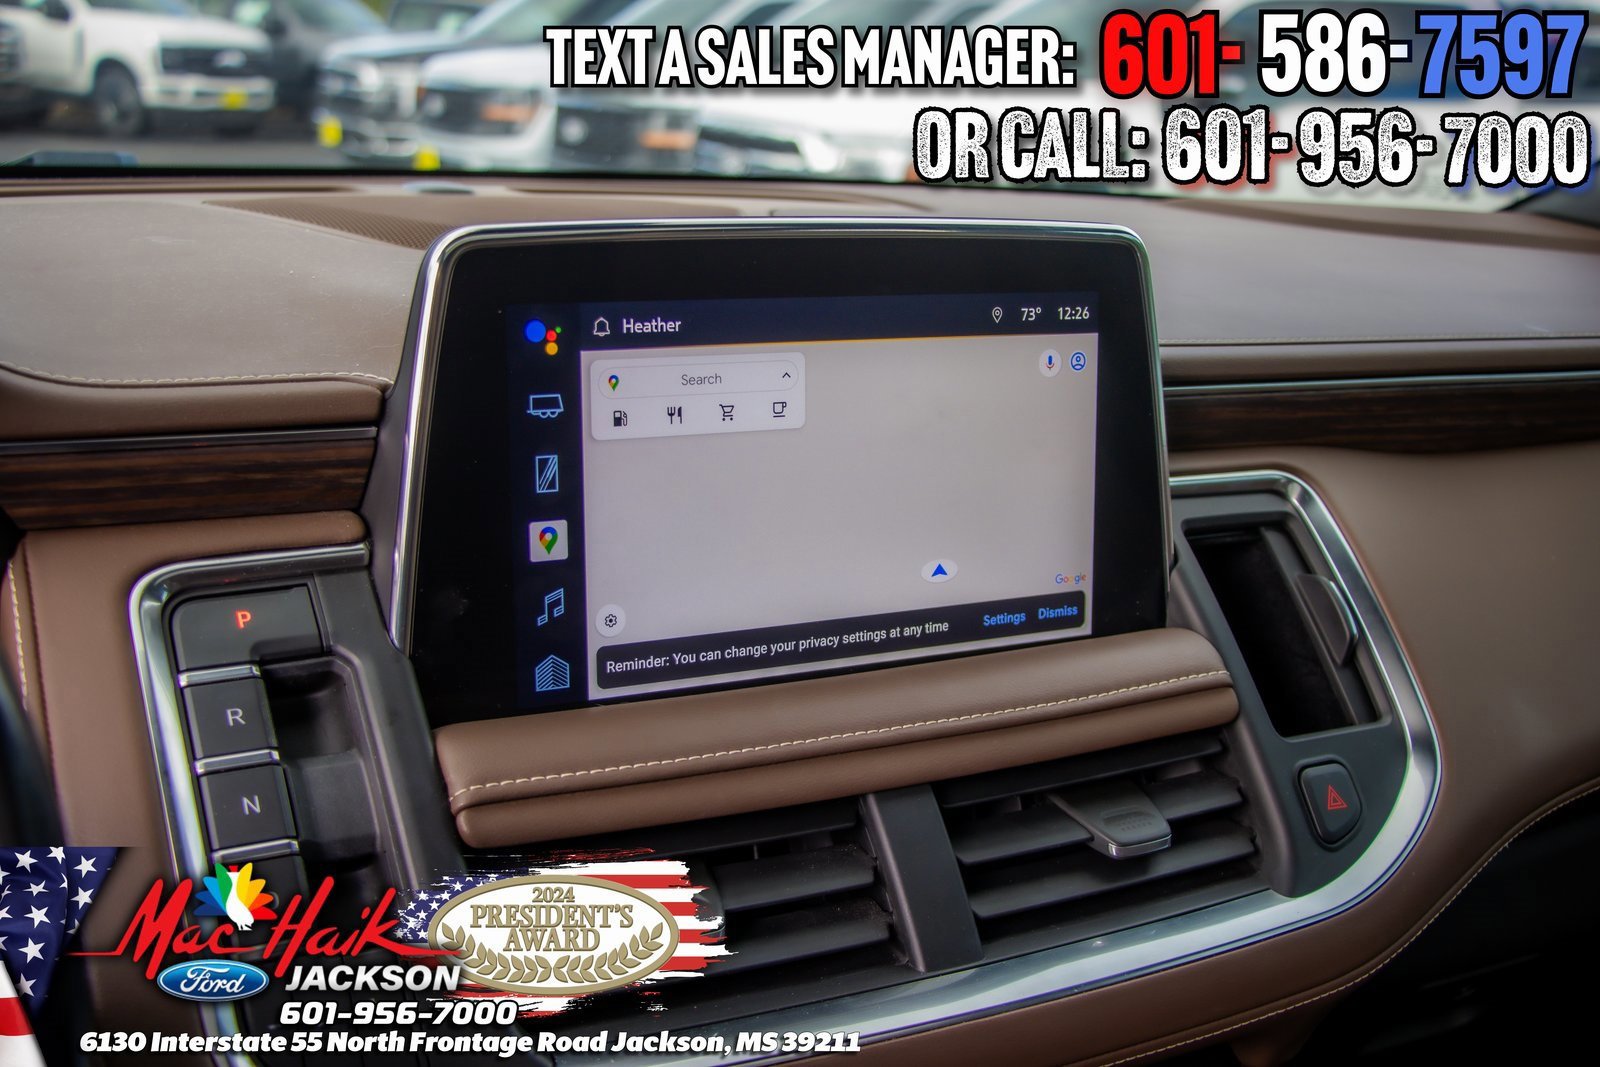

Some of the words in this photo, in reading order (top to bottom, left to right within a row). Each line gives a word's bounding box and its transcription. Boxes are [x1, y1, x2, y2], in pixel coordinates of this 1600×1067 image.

[1021, 306, 1042, 322] 73°
[1057, 305, 1090, 321] 12:26
[622, 316, 681, 334] Heather
[680, 371, 722, 388] Search
[1055, 572, 1087, 585] Google
[234, 609, 251, 629] P
[983, 610, 1026, 626] Settings
[1037, 604, 1078, 620] Dismiss
[606, 655, 670, 673] Reminder:
[672, 652, 696, 665] You
[699, 651, 721, 662] can
[724, 643, 767, 659] change
[770, 640, 795, 655] your
[799, 634, 840, 652] privacy
[842, 629, 887, 644] settings
[890, 626, 901, 638] at
[904, 624, 923, 637] any
[924, 620, 949, 633] time
[226, 708, 246, 728] R
[241, 795, 261, 816] N
